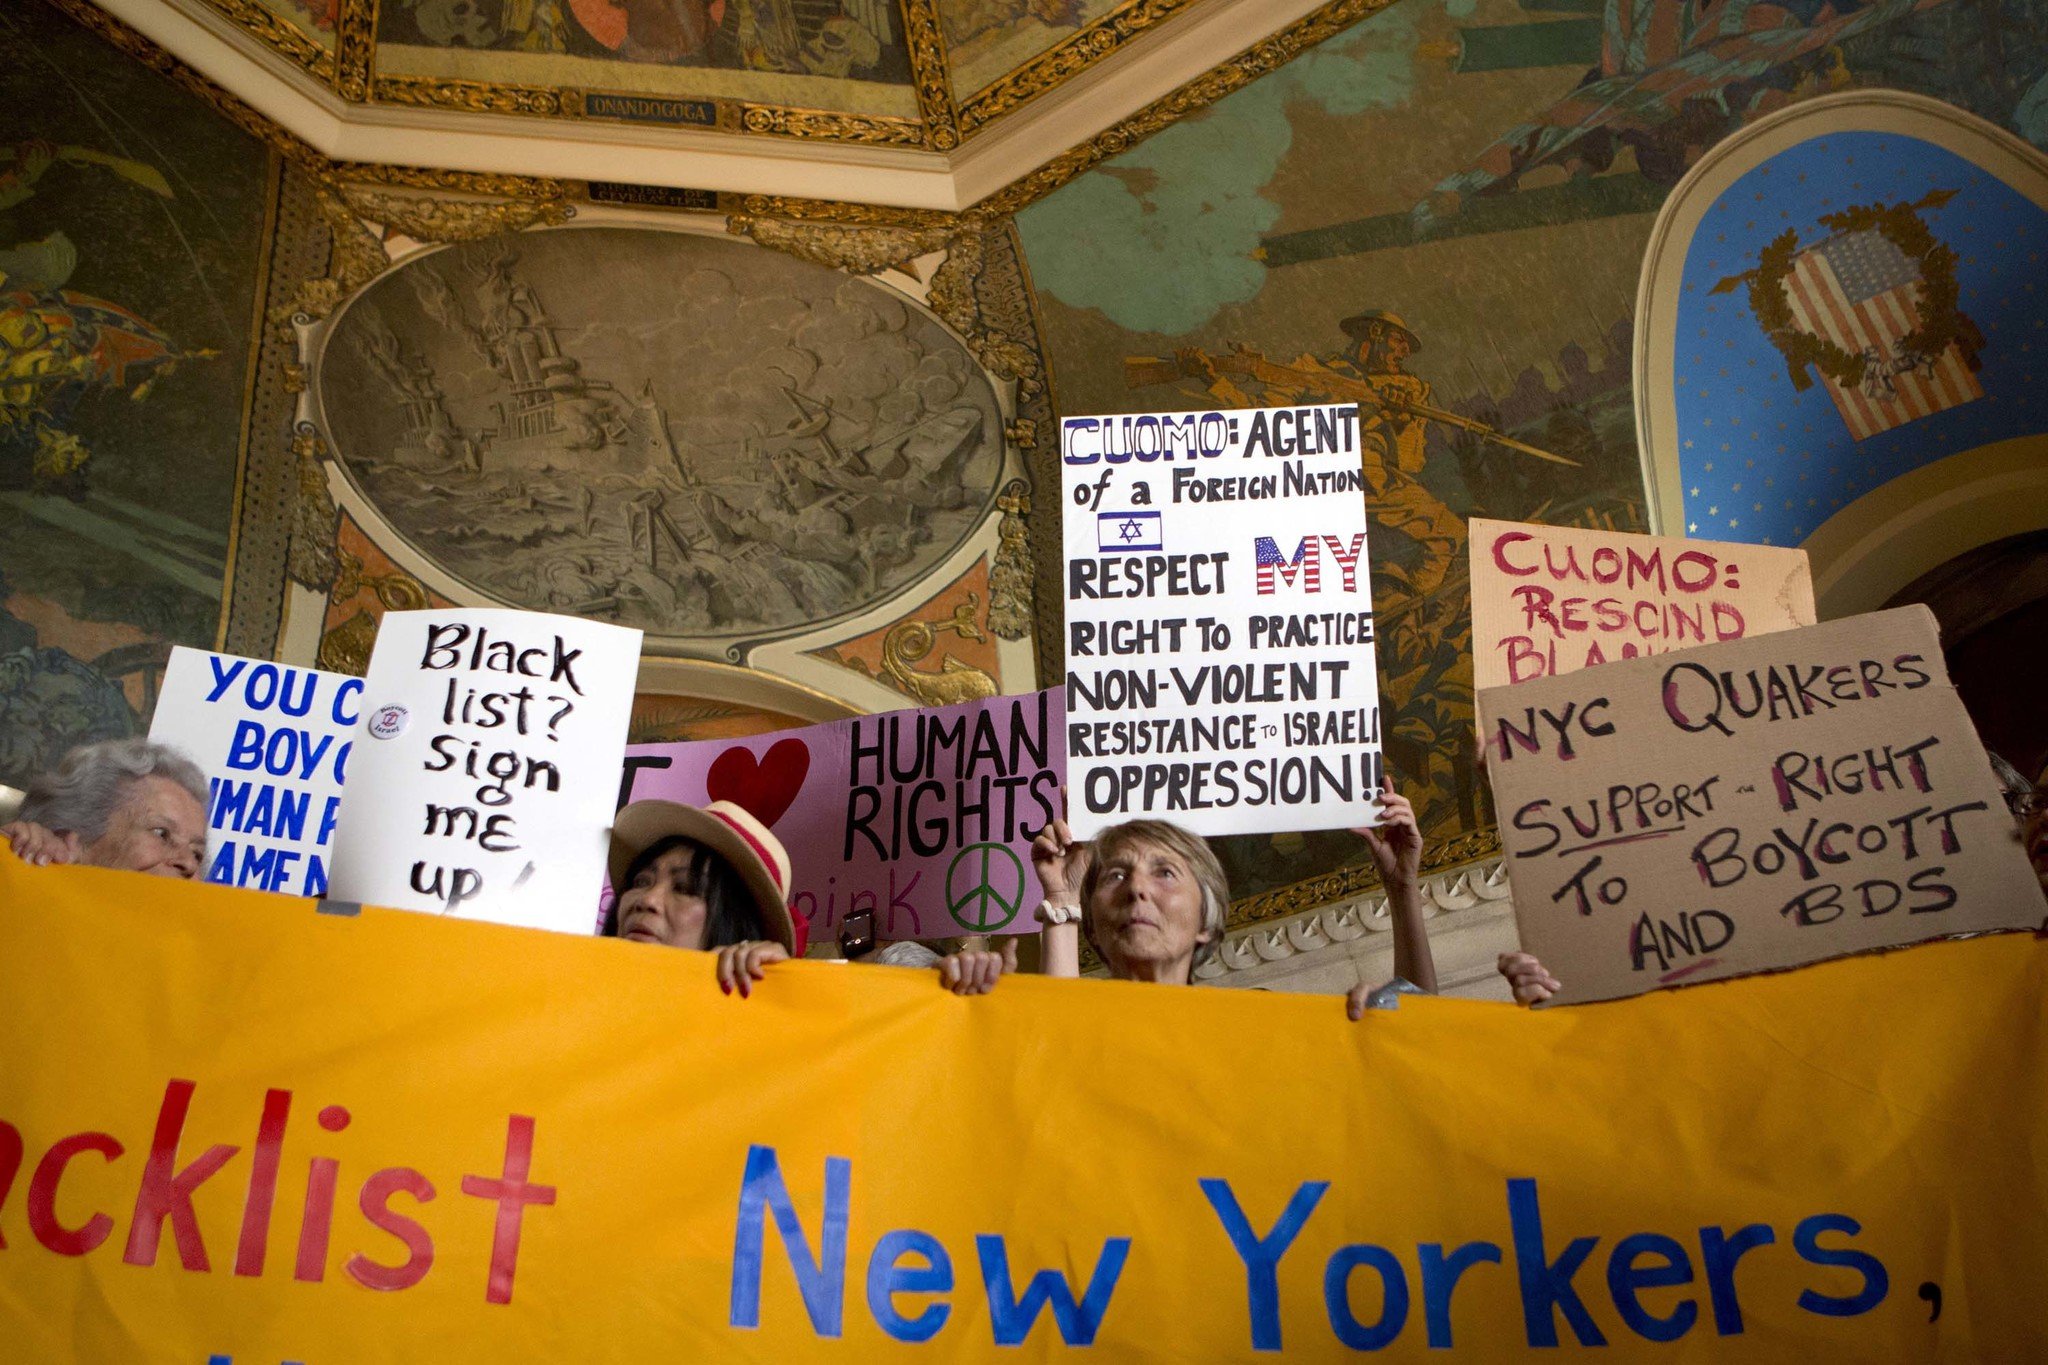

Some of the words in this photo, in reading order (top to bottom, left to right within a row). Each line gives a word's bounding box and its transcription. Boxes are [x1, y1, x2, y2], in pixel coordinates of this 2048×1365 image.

[1064, 412, 1239, 465] CUOMO:
[1243, 408, 1358, 458] AGENT
[1074, 469, 1114, 511] of
[1131, 481, 1152, 504] a
[1069, 553, 1229, 599] RESPECT
[1254, 533, 1367, 595] MY
[1492, 532, 1742, 595] CUOMO:
[1070, 617, 1187, 656] RIGHT
[1249, 613, 1374, 649] PRACTICE
[1511, 585, 1745, 642] RESCIND
[205, 656, 318, 717] YOU
[420, 623, 585, 697] Black
[1067, 661, 1349, 712] NON-VIOLENT
[443, 677, 573, 742] list?
[850, 691, 1048, 786] HUMAN
[1069, 714, 1256, 757] RESISTANCE
[1261, 724, 1277, 739] TO
[1284, 707, 1378, 746] ISRAELI
[1495, 698, 1616, 762] NYC
[1662, 654, 1932, 737] QUAKERS
[424, 734, 560, 806] Sign
[1085, 751, 1385, 814] OPPRESSION!!
[1514, 775, 1720, 859] SUPPORT
[1772, 736, 1941, 813] RIGHT
[844, 770, 1059, 862] RIGHTS
[1691, 800, 1988, 889] BOYCOTT
[1630, 909, 1736, 974] AND
[1781, 866, 1959, 927] BDS
[729, 1143, 1133, 1347] New
[1197, 1176, 1943, 1352] Yorkers,
